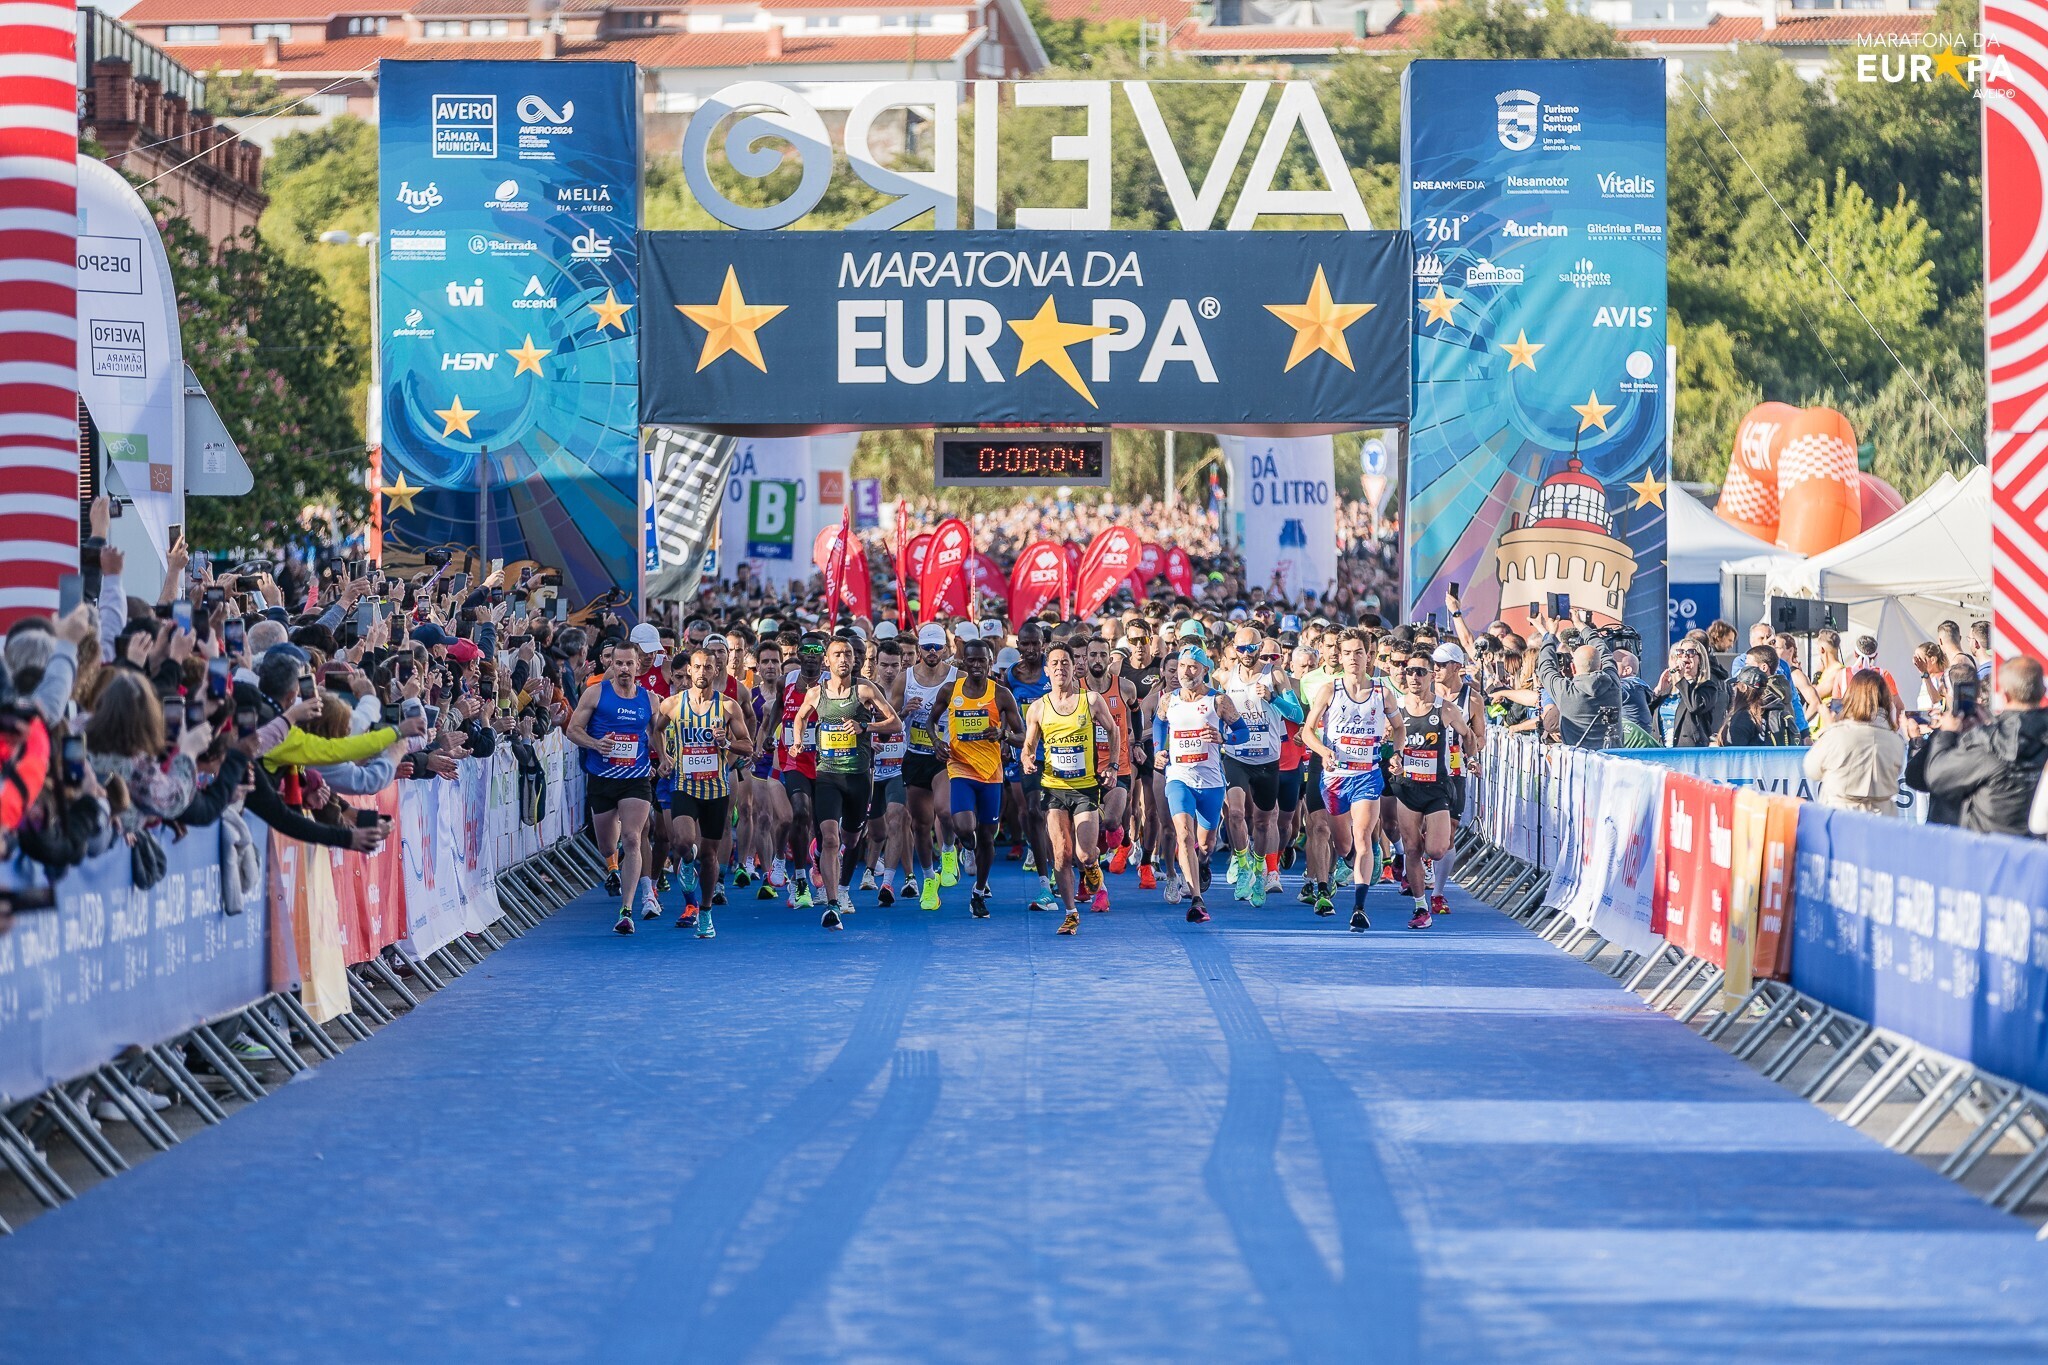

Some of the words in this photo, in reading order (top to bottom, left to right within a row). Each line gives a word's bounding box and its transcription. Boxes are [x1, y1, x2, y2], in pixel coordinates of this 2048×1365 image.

[437, 103, 492, 119] AVEIRO
[1543, 105, 1579, 114] Turismo
[1543, 115, 1573, 123] Centro
[1543, 124, 1581, 134] Portugal
[437, 142, 492, 152] MUNICIPAL
[1413, 181, 1485, 190] DREAMMEDIA
[1507, 175, 1569, 187] Nasamotor
[1597, 171, 1655, 193] Vitalis
[396, 181, 443, 207] hug
[1502, 219, 1568, 238] Auchan
[1635, 223, 1662, 233] Plaza
[488, 240, 537, 251] Bairrada
[838, 252, 1075, 289] MARATONA
[1082, 252, 1144, 288] DA
[1469, 270, 1521, 280] BemBoa
[1559, 272, 1611, 284] salpoente
[445, 278, 484, 307] tvi
[512, 297, 557, 309] ascendi
[979, 448, 1084, 472] 0:00:04
[1252, 448, 1278, 479] DÁ
[857, 480, 875, 514] E
[1252, 482, 1264, 506] O
[1271, 480, 1329, 505] LITRO
[696, 481, 717, 527] SPORTS
[756, 482, 787, 535] B
[939, 548, 961, 564] BDR
[1102, 553, 1128, 565] BDR
[1030, 569, 1058, 583] BDR
[961, 718, 982, 727] 1586
[828, 733, 848, 742] 1628
[1346, 746, 1368, 756] 8408
[688, 756, 712, 766] 8645
[1056, 756, 1078, 764] 1086
[1410, 758, 1430, 768] 8616
